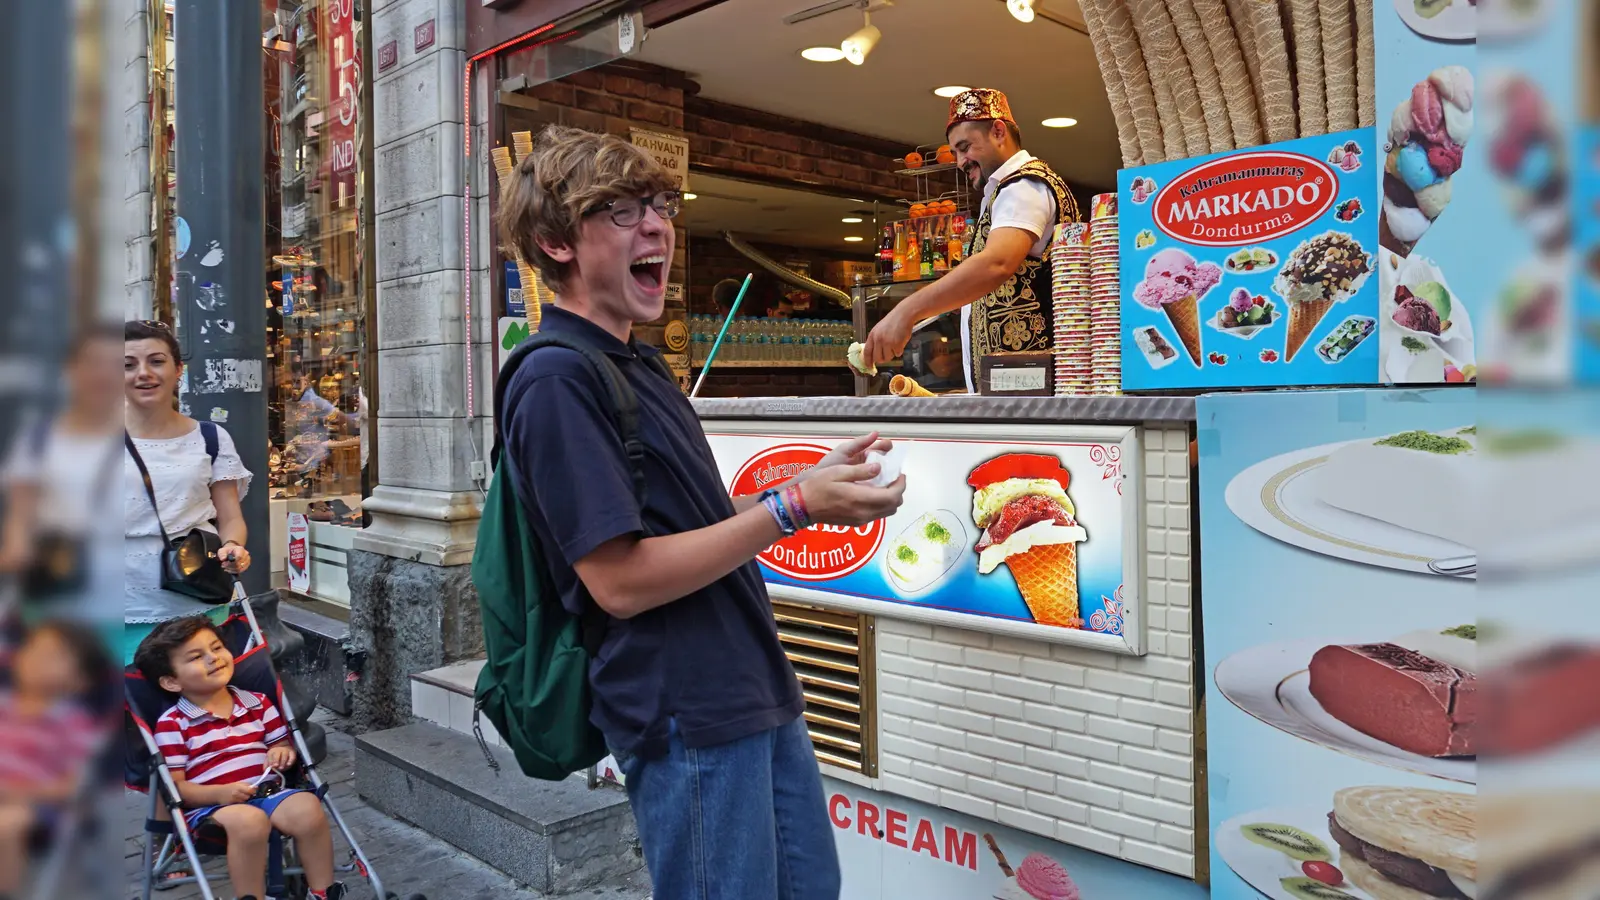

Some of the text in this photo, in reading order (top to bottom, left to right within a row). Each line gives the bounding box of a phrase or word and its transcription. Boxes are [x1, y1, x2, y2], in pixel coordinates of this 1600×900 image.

[635, 136, 684, 157] KAHVALTI
[1178, 165, 1305, 199] Kahramanmaraş
[1190, 212, 1295, 238] Dondurma
[763, 542, 856, 571] ondurma
[829, 793, 977, 871] CREAM
